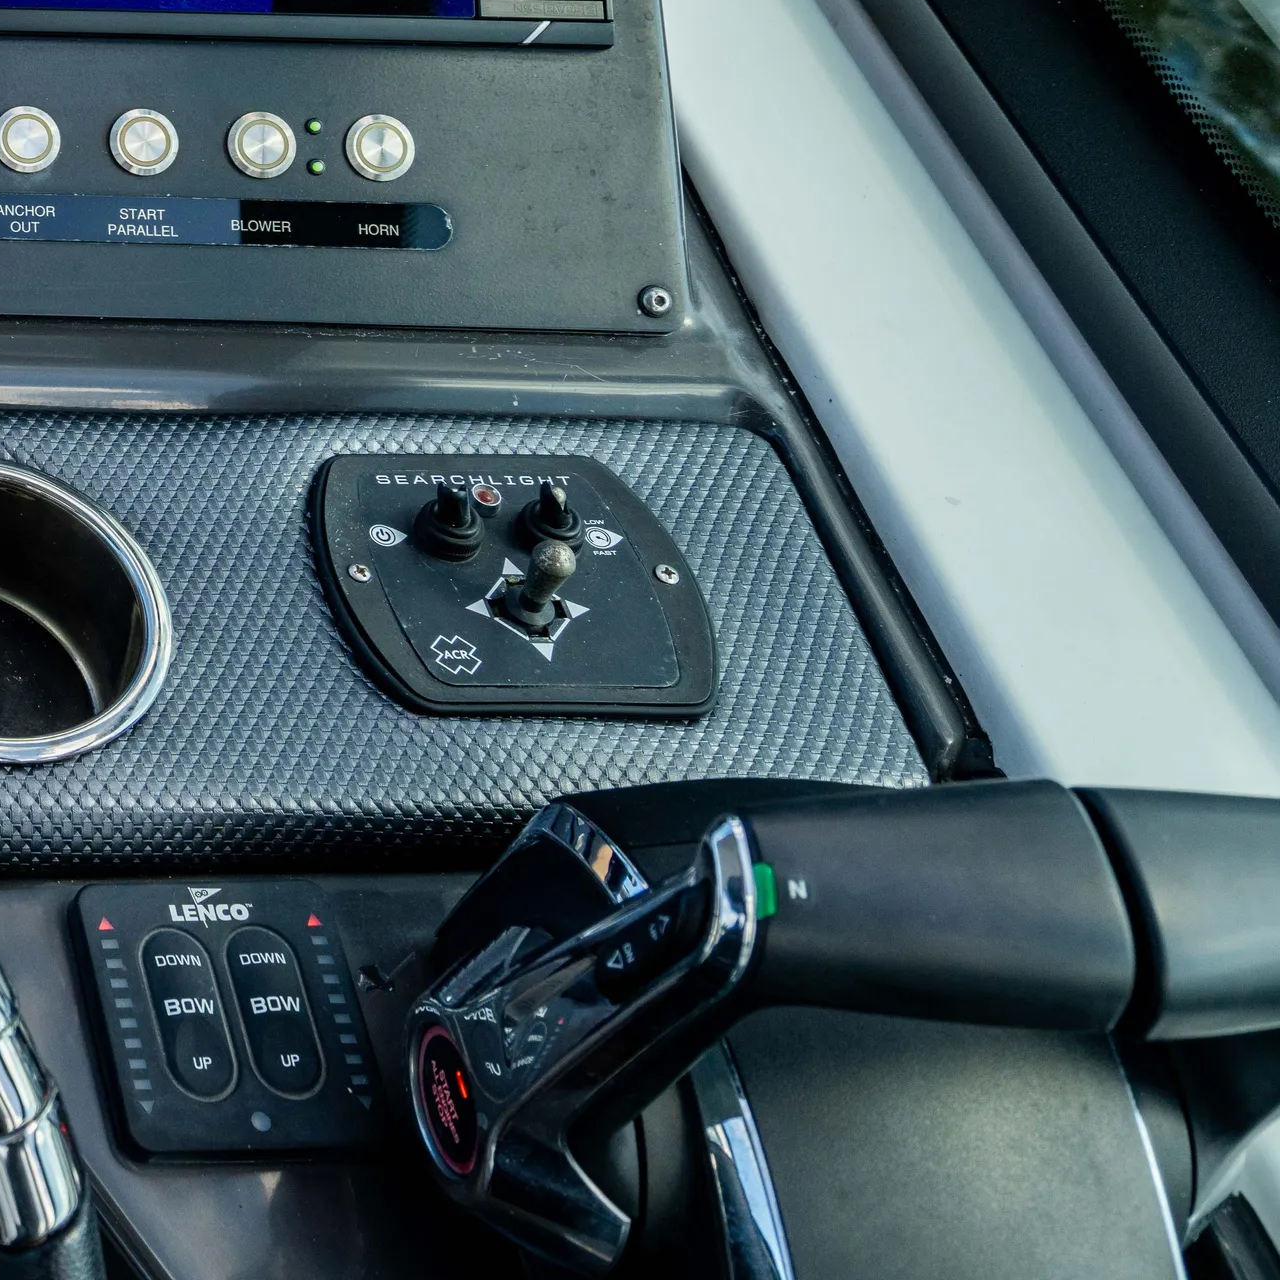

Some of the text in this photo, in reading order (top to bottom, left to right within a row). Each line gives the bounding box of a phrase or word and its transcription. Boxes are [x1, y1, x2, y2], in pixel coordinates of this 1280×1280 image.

[119, 208, 165, 221] START
[10, 221, 40, 233] OUT
[108, 224, 178, 237] PARALLEL
[231, 219, 291, 233] BLOWER
[359, 224, 399, 237] HORN
[375, 474, 570, 487] SEARCHLIGHT
[443, 649, 468, 661] ACR
[788, 879, 808, 900] N
[239, 952, 287, 965] DOWN
[622, 942, 635, 964] DN
[155, 954, 202, 967] DOWN
[164, 997, 214, 1016] BOW
[250, 995, 300, 1014] BOW
[193, 1056, 212, 1070] UP
[280, 1054, 300, 1067] UP
[440, 1070, 459, 1120] START
[432, 1083, 448, 1127] STOP
